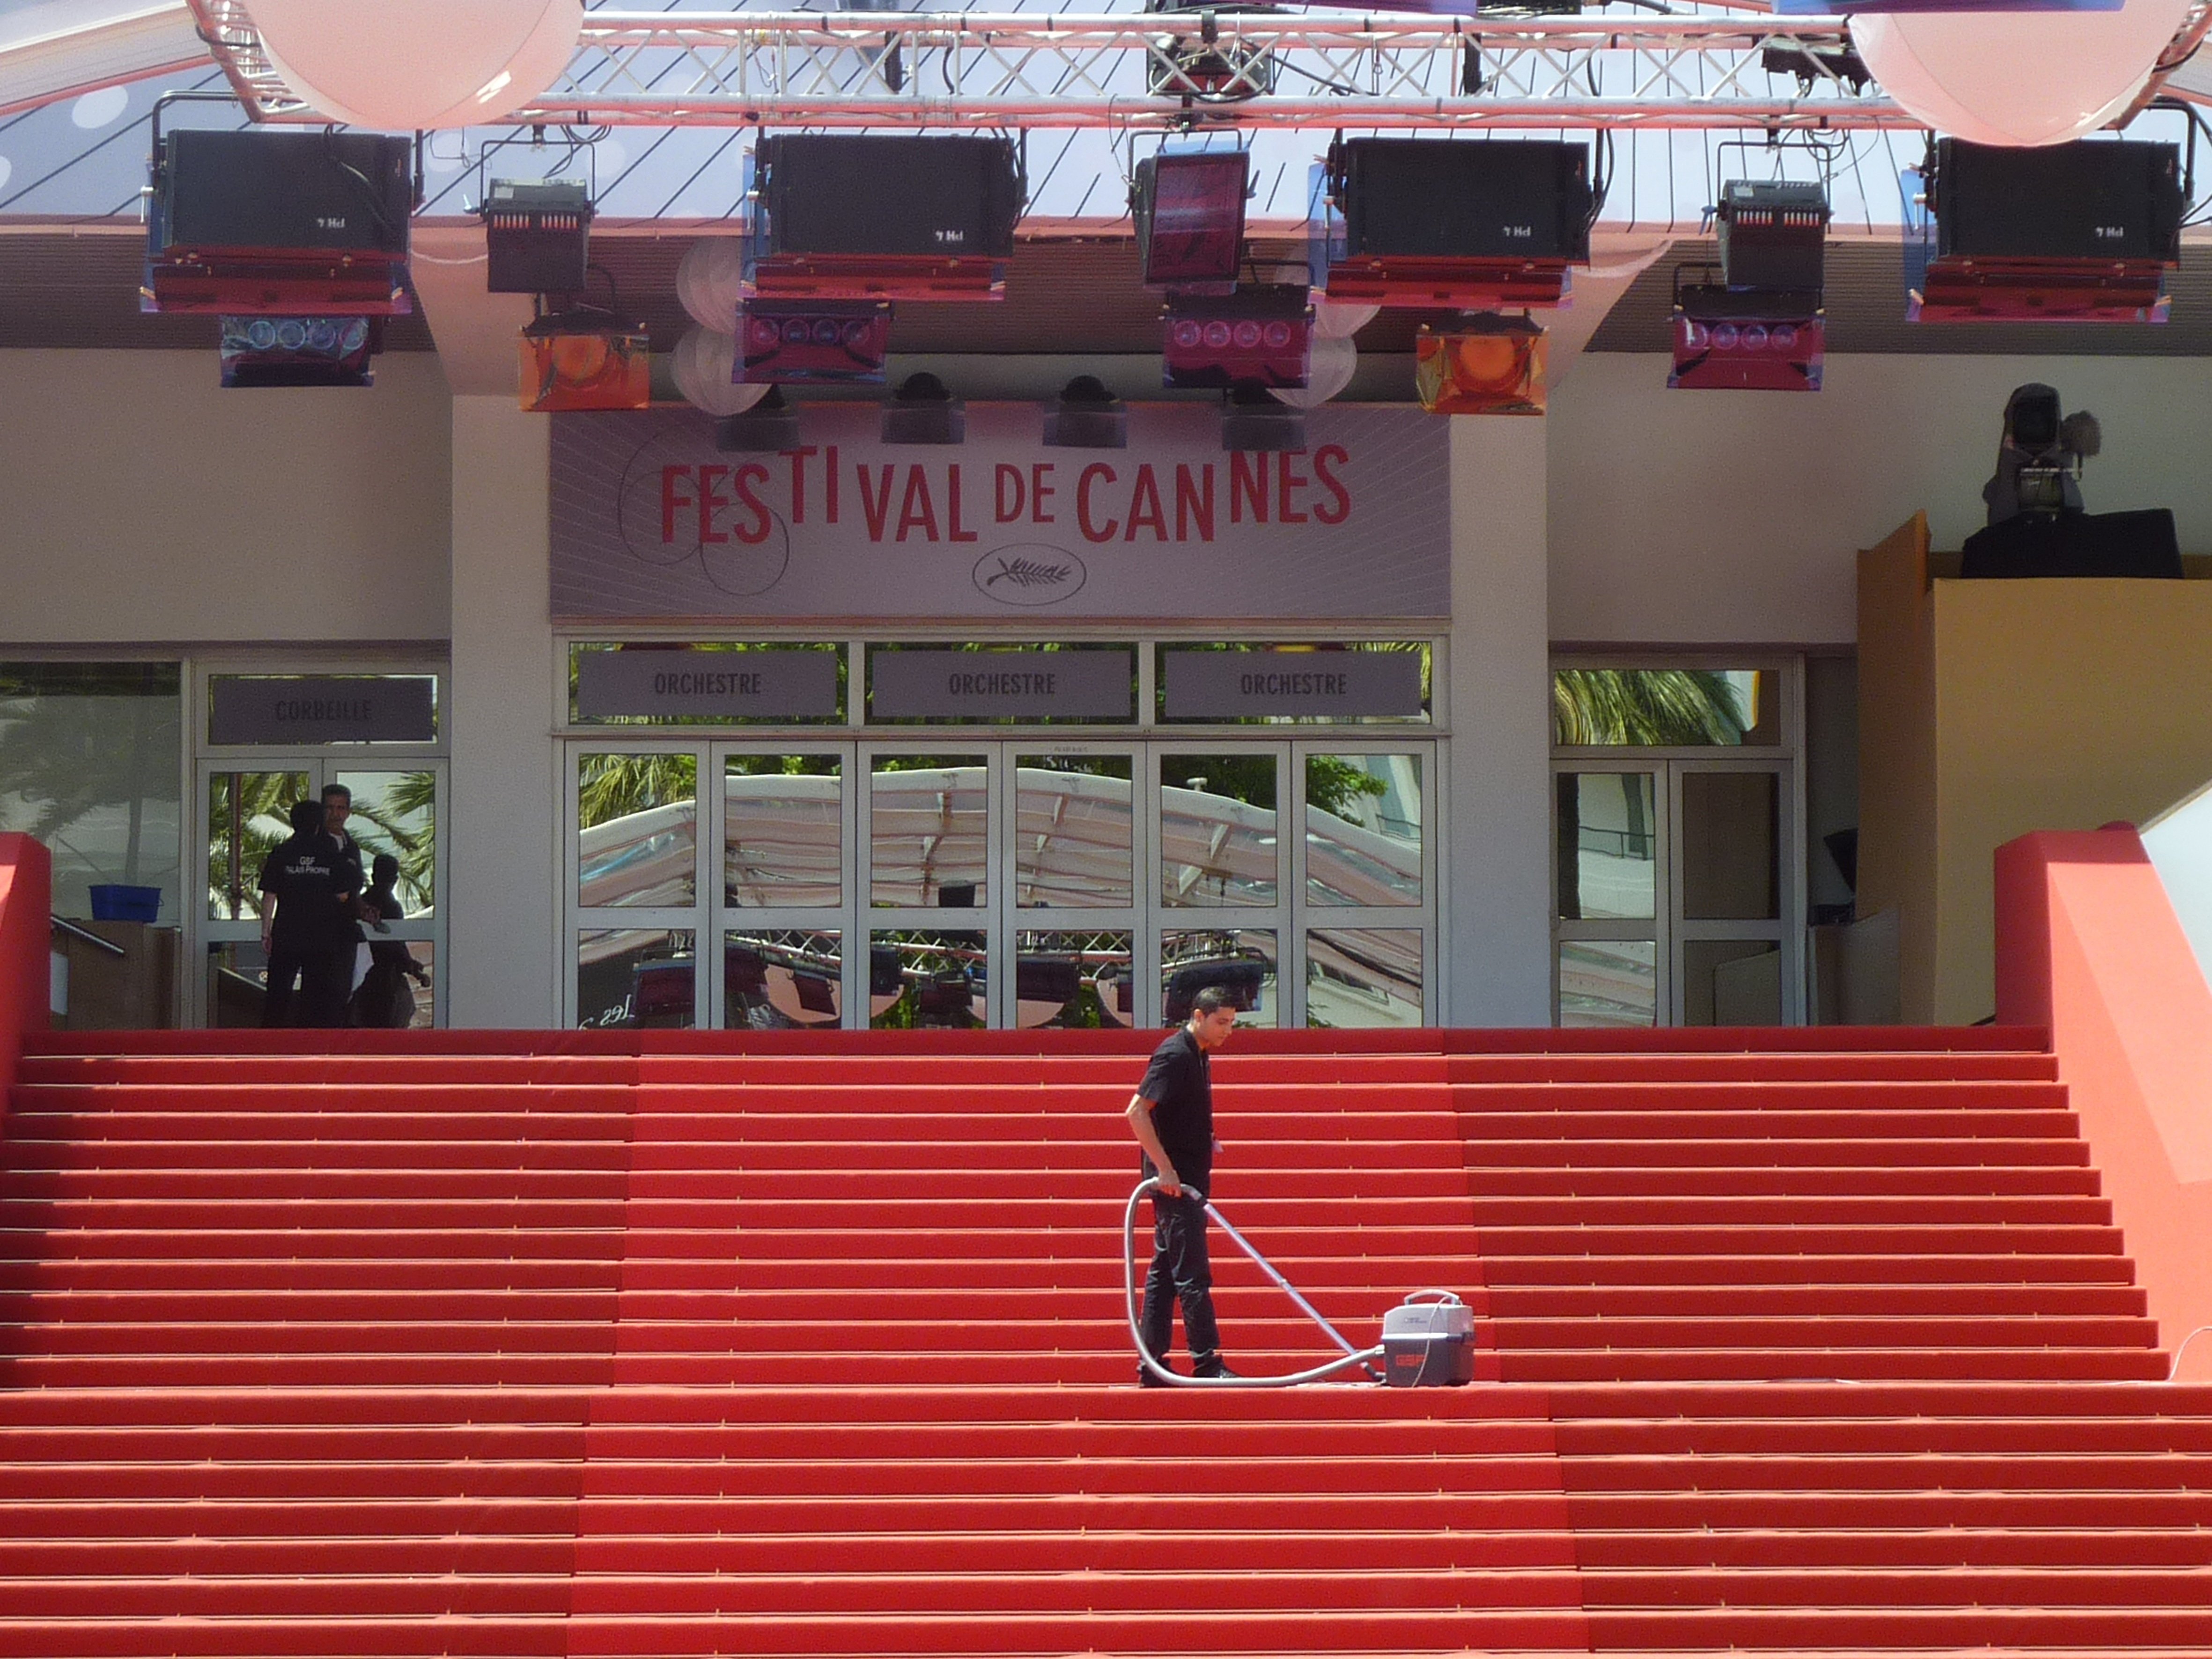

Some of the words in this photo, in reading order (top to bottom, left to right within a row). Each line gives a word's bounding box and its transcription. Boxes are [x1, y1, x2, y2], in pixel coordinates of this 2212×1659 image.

[661, 445, 978, 544] FESTIVAL
[995, 463, 1055, 524] DE
[1077, 444, 1350, 543] CANNES
[656, 673, 761, 694] ORCHESTRE
[949, 673, 1055, 695] ORCHESTRE
[1242, 673, 1347, 694] ORCHESTRE
[276, 700, 372, 721] CORBEILLE
